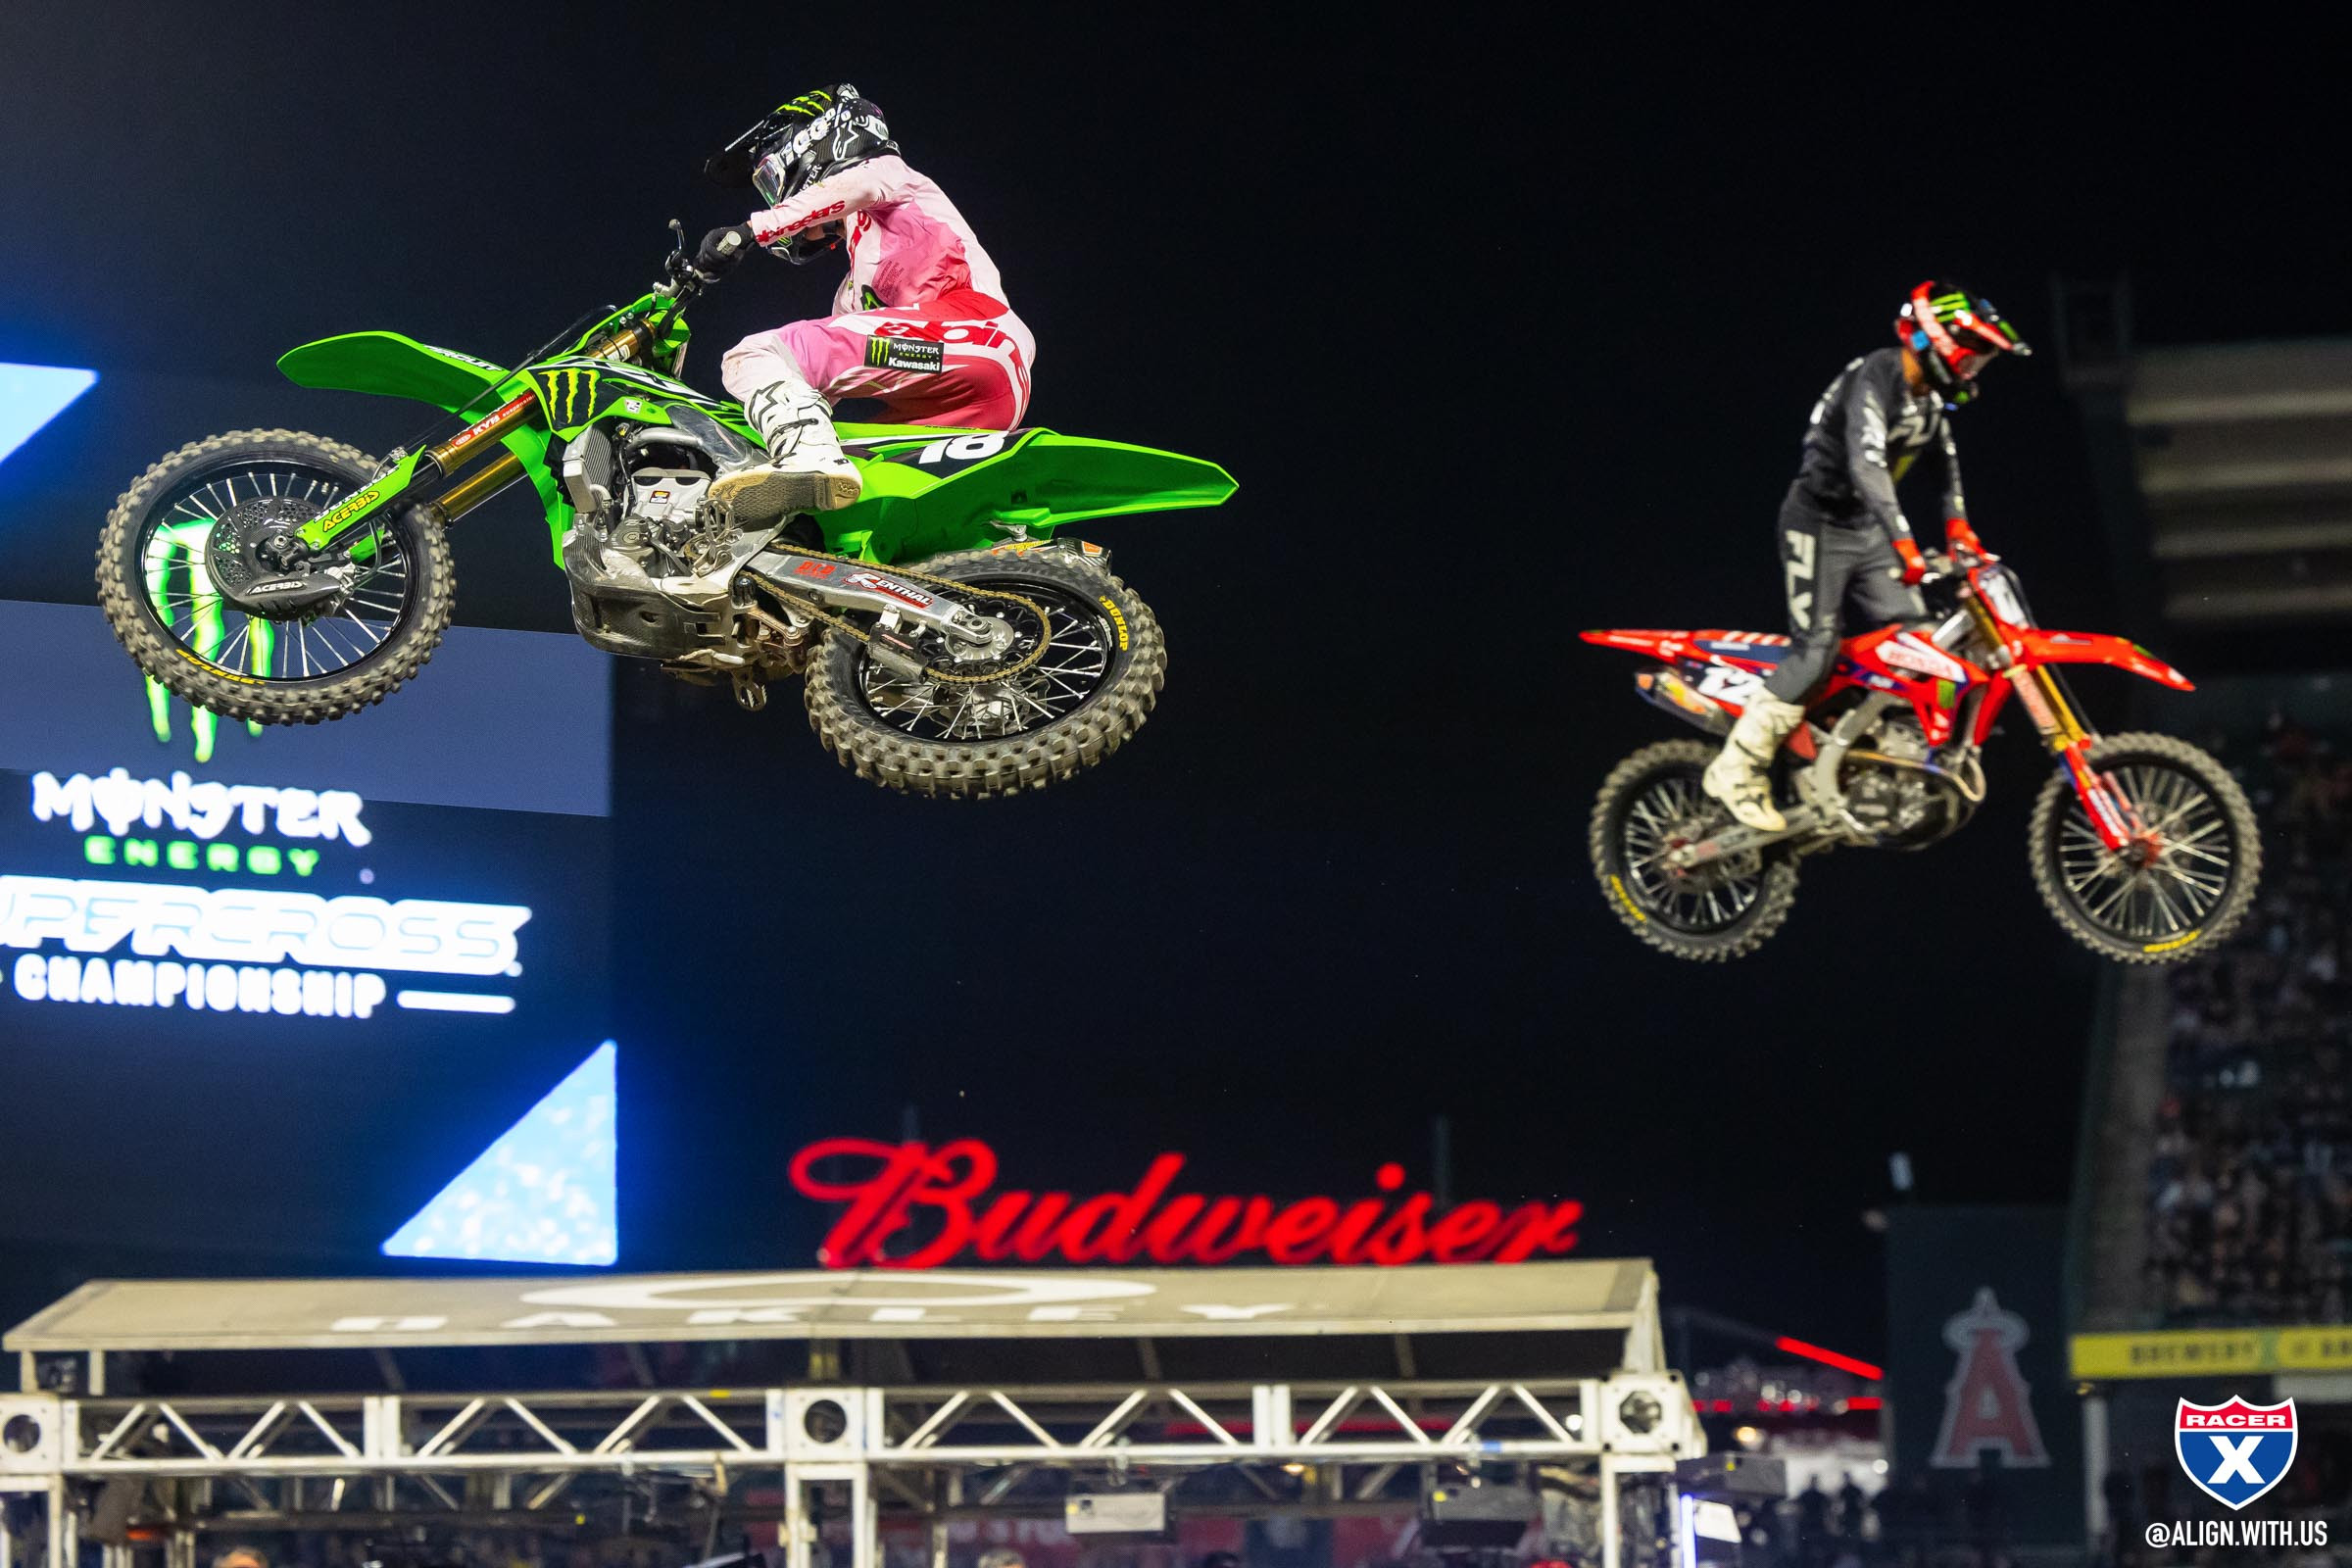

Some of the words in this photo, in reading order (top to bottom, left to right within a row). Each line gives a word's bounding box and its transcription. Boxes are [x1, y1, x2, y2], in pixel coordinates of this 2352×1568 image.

[888, 357, 941, 371] Kawasaki
[893, 342, 940, 356] MONSTER
[472, 415, 501, 436] KYB
[918, 431, 1009, 465] 18
[322, 490, 380, 532] ACERBIS
[249, 581, 303, 595] ACERBIS
[1787, 529, 1815, 630] FLY
[1103, 599, 1129, 652] DUNLOP
[31, 767, 371, 847] MONSTER
[84, 835, 319, 876] ENERGY
[14, 954, 386, 1018] CHAMPIONSHIP
[789, 1138, 1584, 1269] Budweiser
[330, 1302, 1293, 1332] OAKLEY
[1932, 1286, 2050, 1468] A
